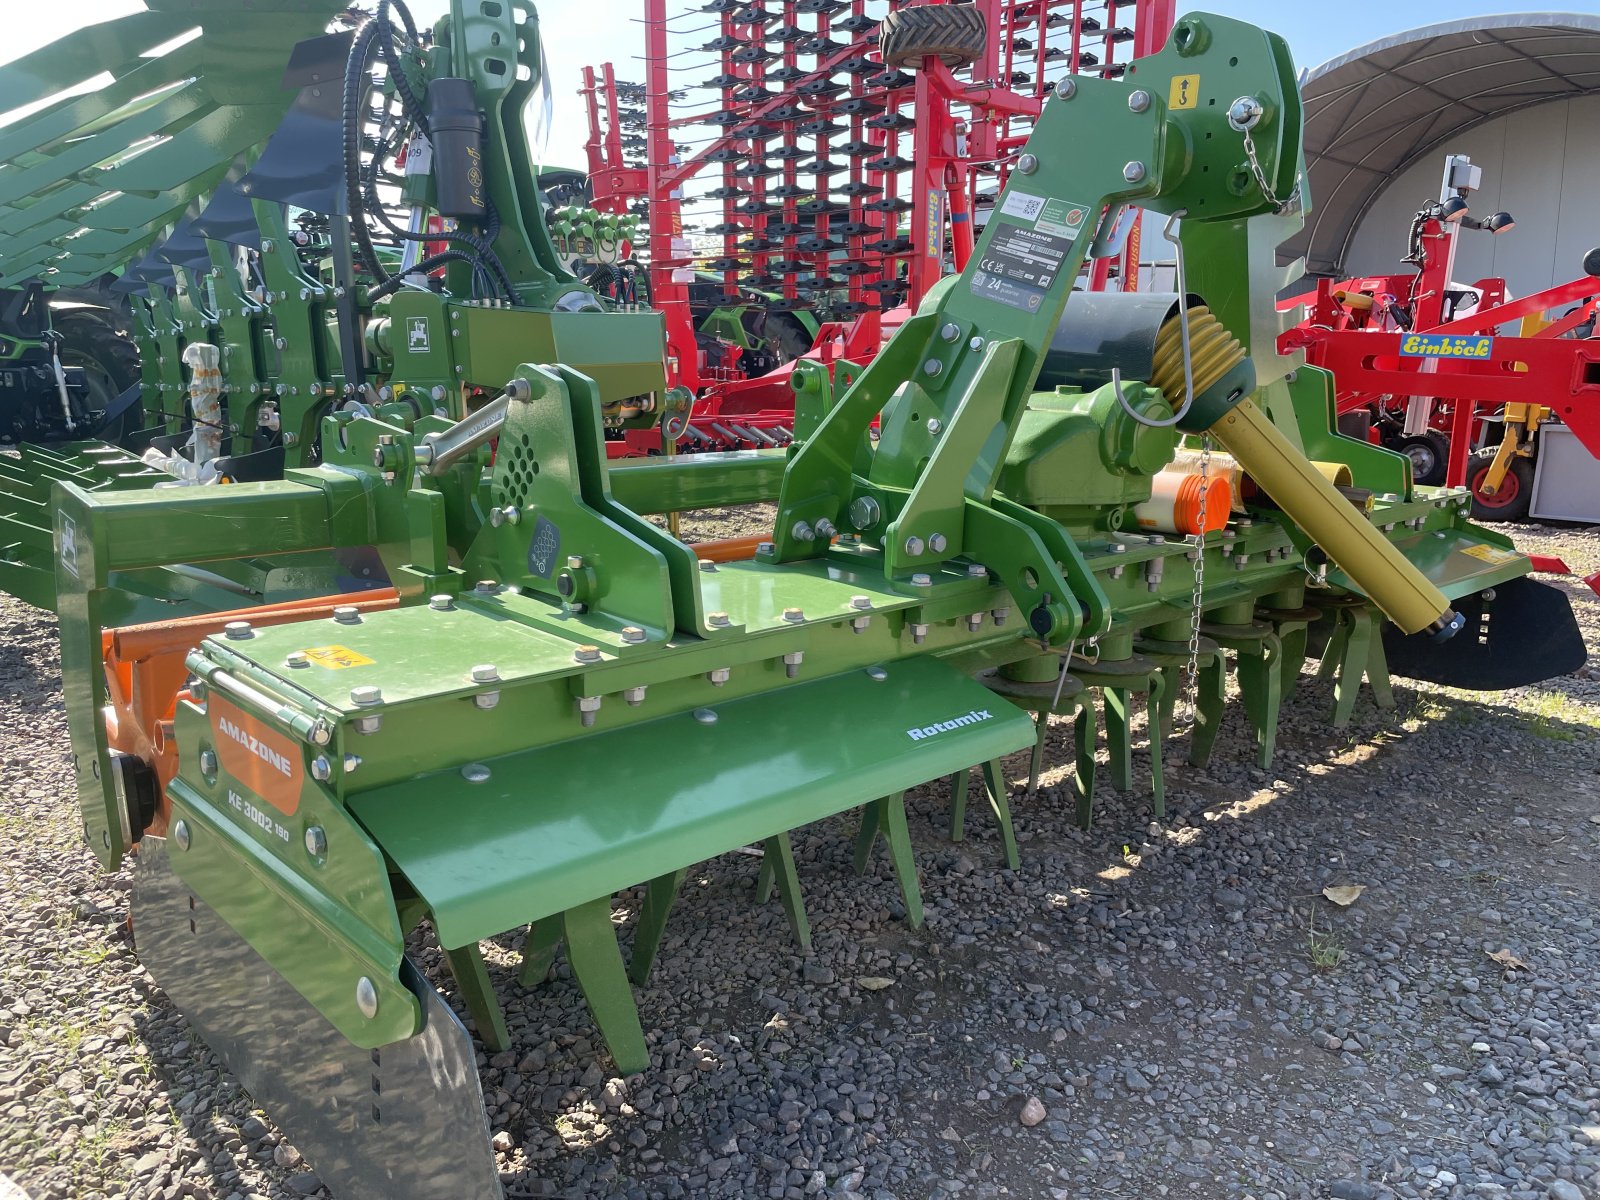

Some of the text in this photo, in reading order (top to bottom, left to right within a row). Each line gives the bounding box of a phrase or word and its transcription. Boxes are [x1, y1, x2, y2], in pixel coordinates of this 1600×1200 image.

[929, 192, 938, 255] Einböck
[1014, 229, 1053, 243] AMAZONE
[987, 277, 1002, 291] 24
[1403, 336, 1490, 357] Einböck
[907, 709, 994, 741] Rotamix
[218, 716, 292, 778] AMAZONE
[228, 789, 290, 842] KE 3002 190
